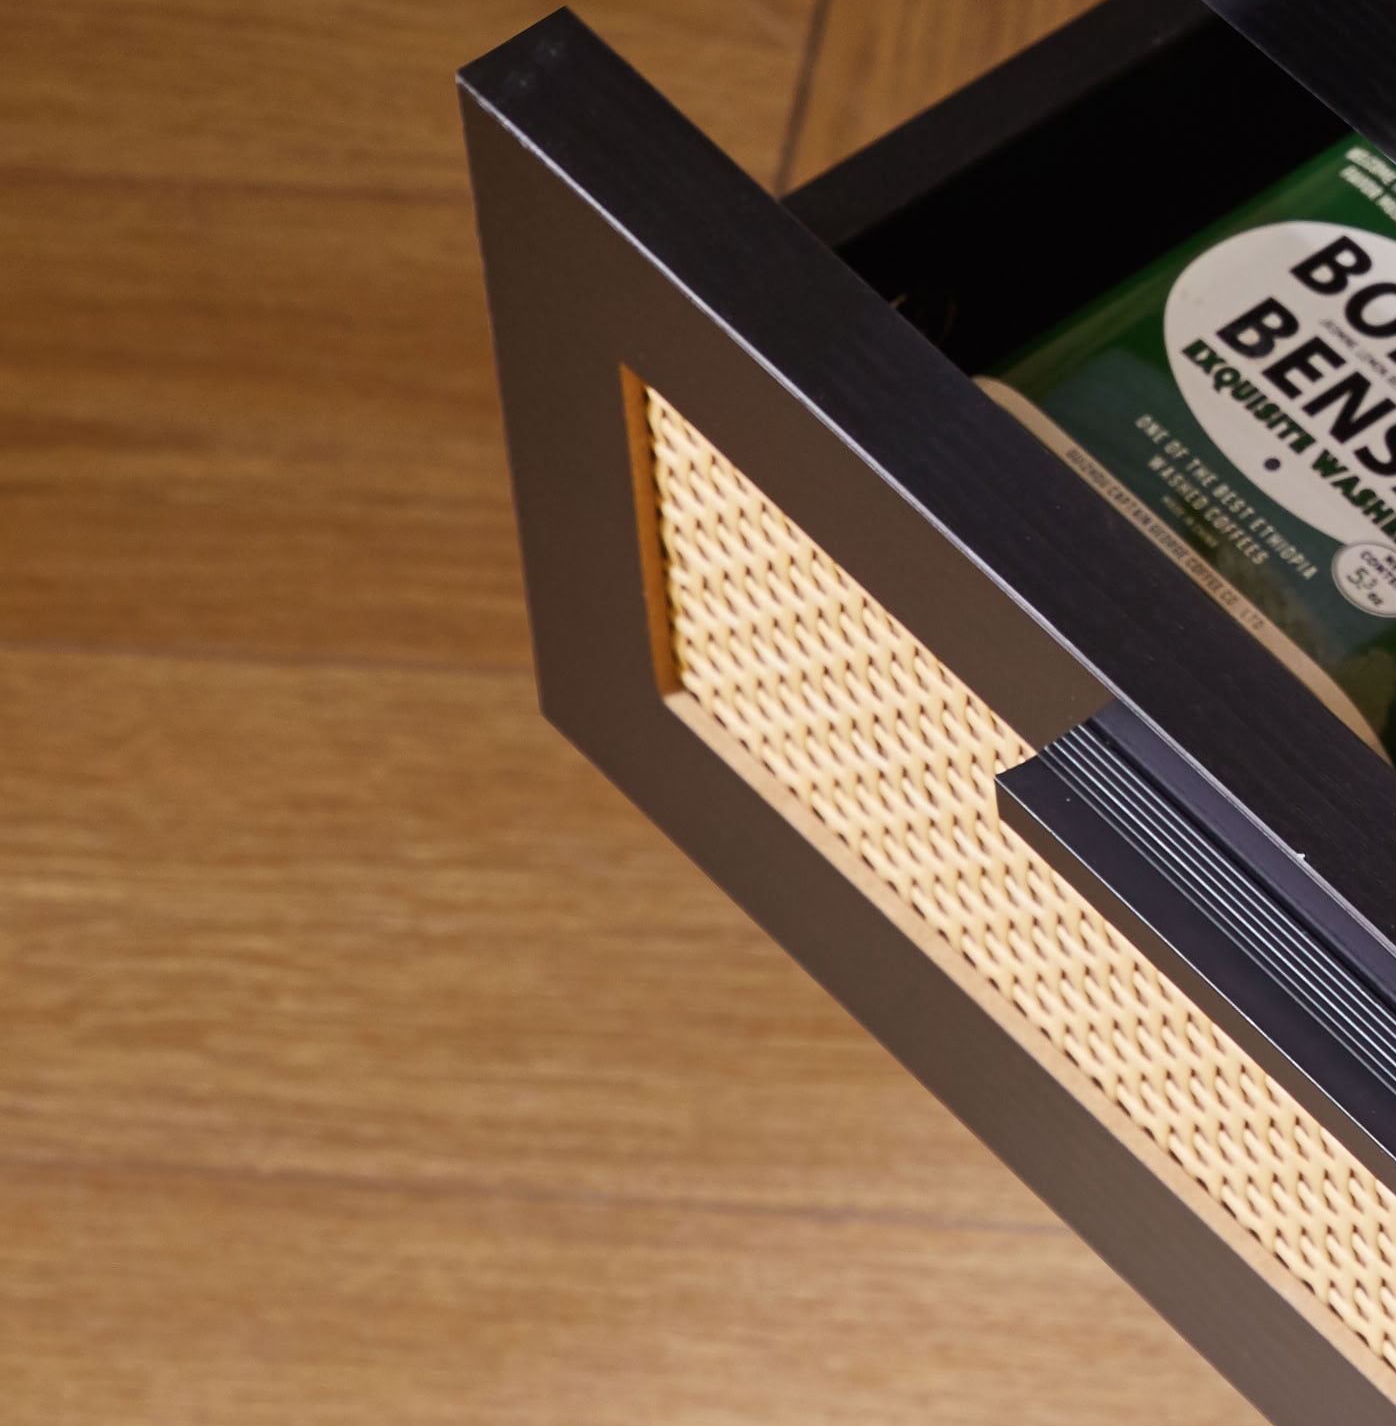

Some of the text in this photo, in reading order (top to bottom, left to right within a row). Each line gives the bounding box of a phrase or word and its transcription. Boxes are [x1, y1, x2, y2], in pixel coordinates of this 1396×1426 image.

[1181, 339, 1314, 456] EXQUISITE
[1134, 413, 1170, 443] ONE
[1163, 439, 1189, 460] OF
[1185, 458, 1218, 486] THE
[1212, 483, 1255, 520] BEST
[1249, 517, 1318, 579] ETHIOPIA
[1147, 454, 1210, 510] WASHED
[1204, 506, 1269, 565] COFFEES
